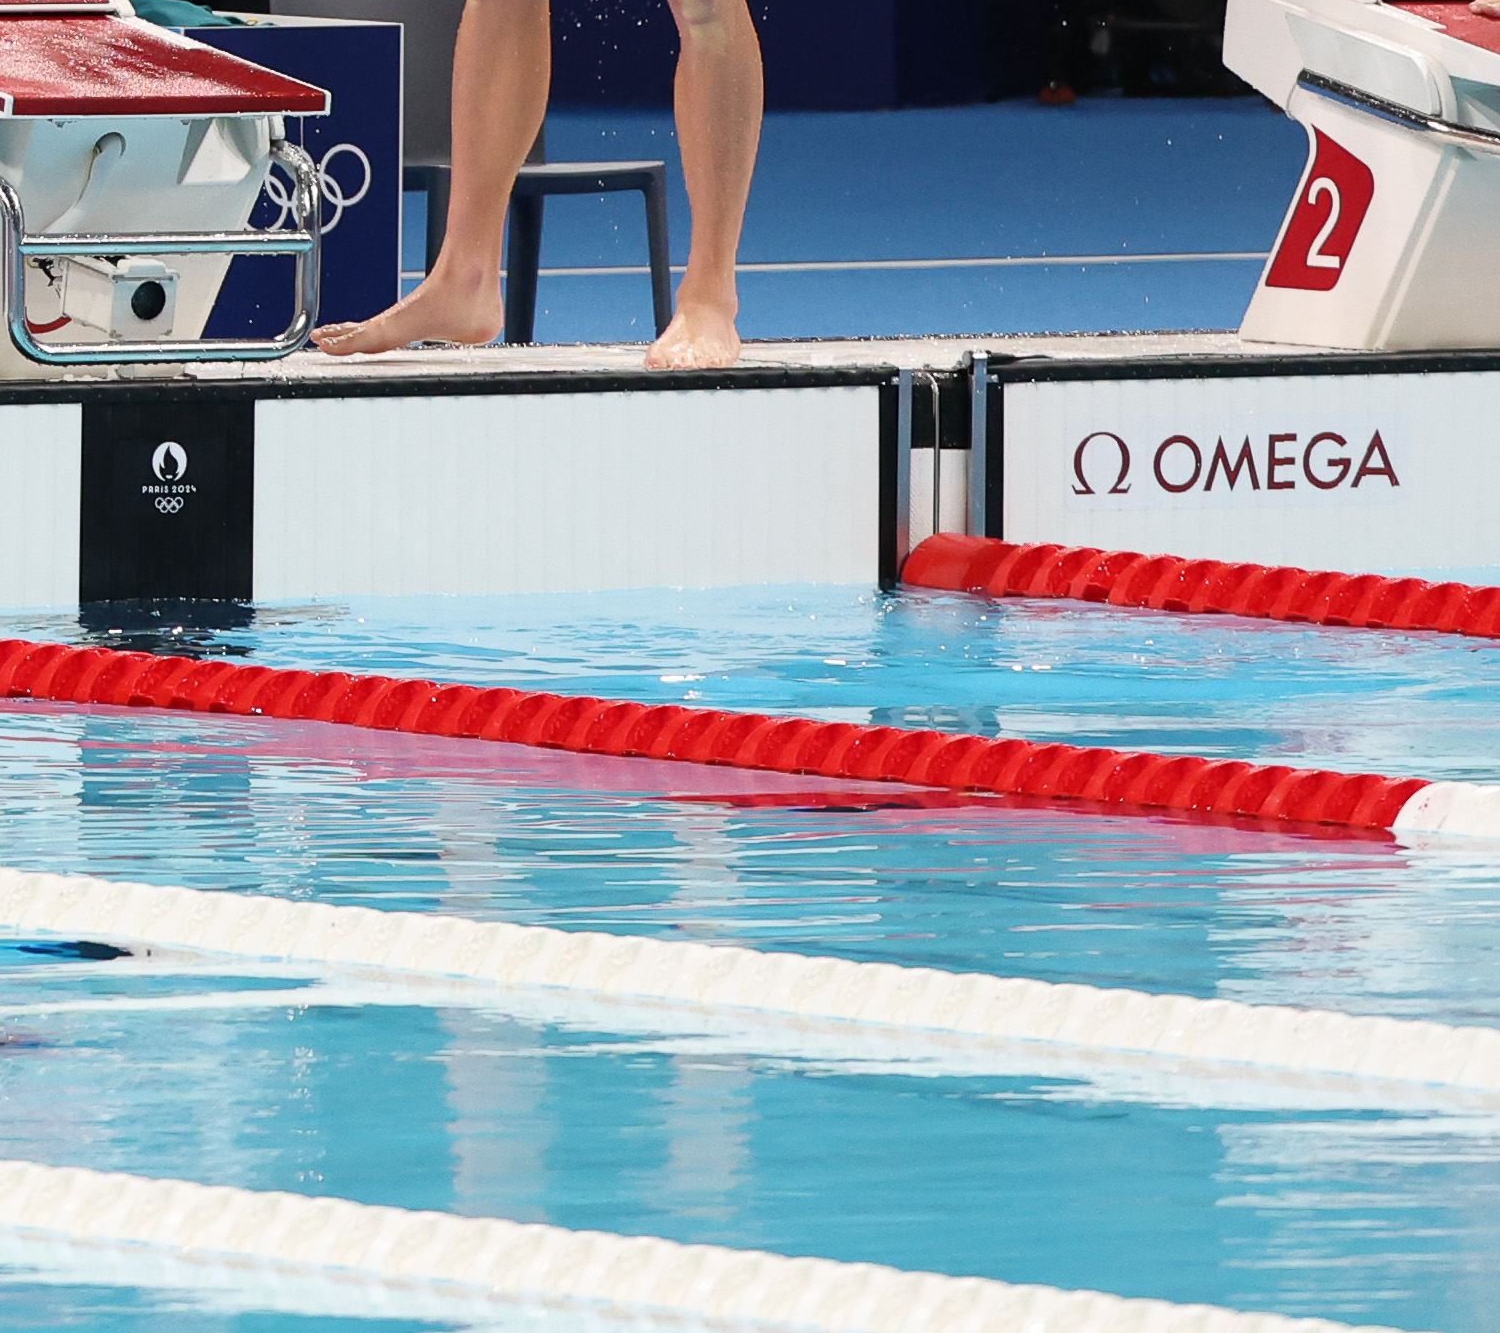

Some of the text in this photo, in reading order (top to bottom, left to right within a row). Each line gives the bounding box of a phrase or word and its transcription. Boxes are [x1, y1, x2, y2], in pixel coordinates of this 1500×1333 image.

[1306, 176, 1341, 269] 2
[141, 484, 197, 494] PARIS 2024
[1152, 429, 1401, 493] OMEGA
